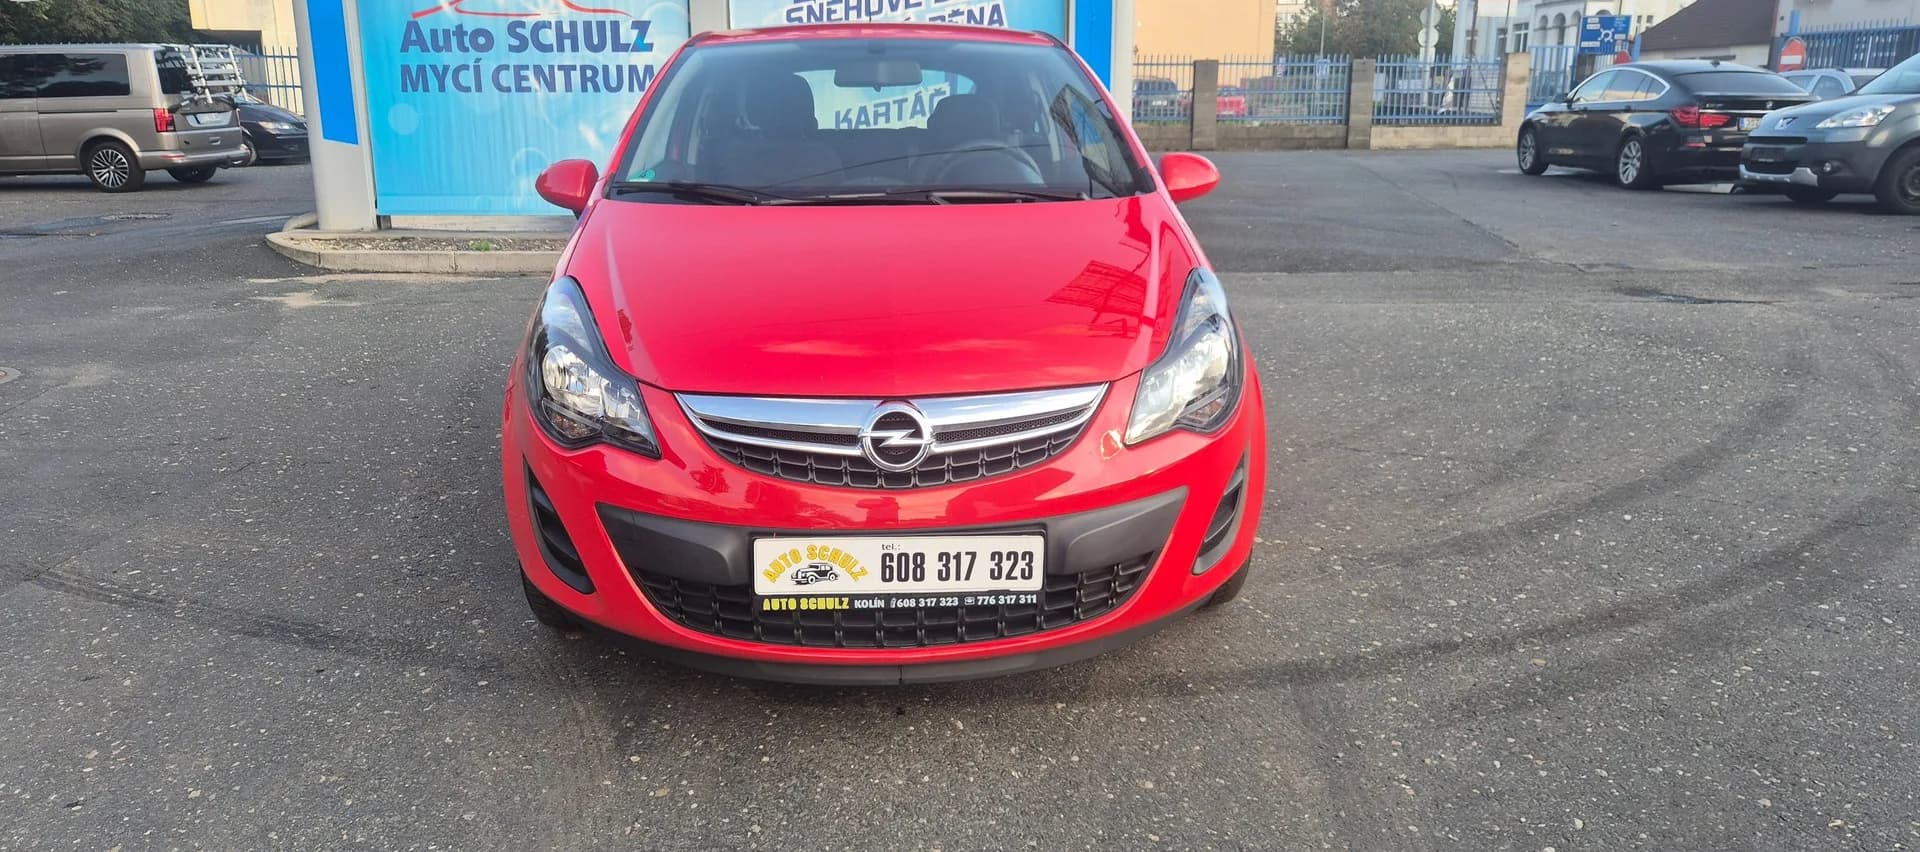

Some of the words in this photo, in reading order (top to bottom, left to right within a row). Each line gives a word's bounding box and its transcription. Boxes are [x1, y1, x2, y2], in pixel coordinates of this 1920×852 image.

[399, 20, 495, 53] Auto
[506, 19, 654, 53] SCHULZ
[400, 58, 483, 93] MYCÍ
[491, 63, 655, 93] CENTRUM
[762, 548, 803, 583] AUTO
[806, 543, 869, 582] SCHULZ
[881, 552, 926, 582] 608
[937, 551, 977, 581] 317
[989, 551, 1034, 580] 323
[762, 598, 797, 610] AUTO
[800, 597, 850, 610] SCHULZ
[854, 597, 885, 609] KOLÍN
[896, 598, 916, 607] 608
[918, 597, 937, 607] 317
[939, 597, 959, 606] 323
[977, 596, 996, 605] 776
[998, 595, 1017, 604] 317
[1019, 594, 1037, 604] 311
